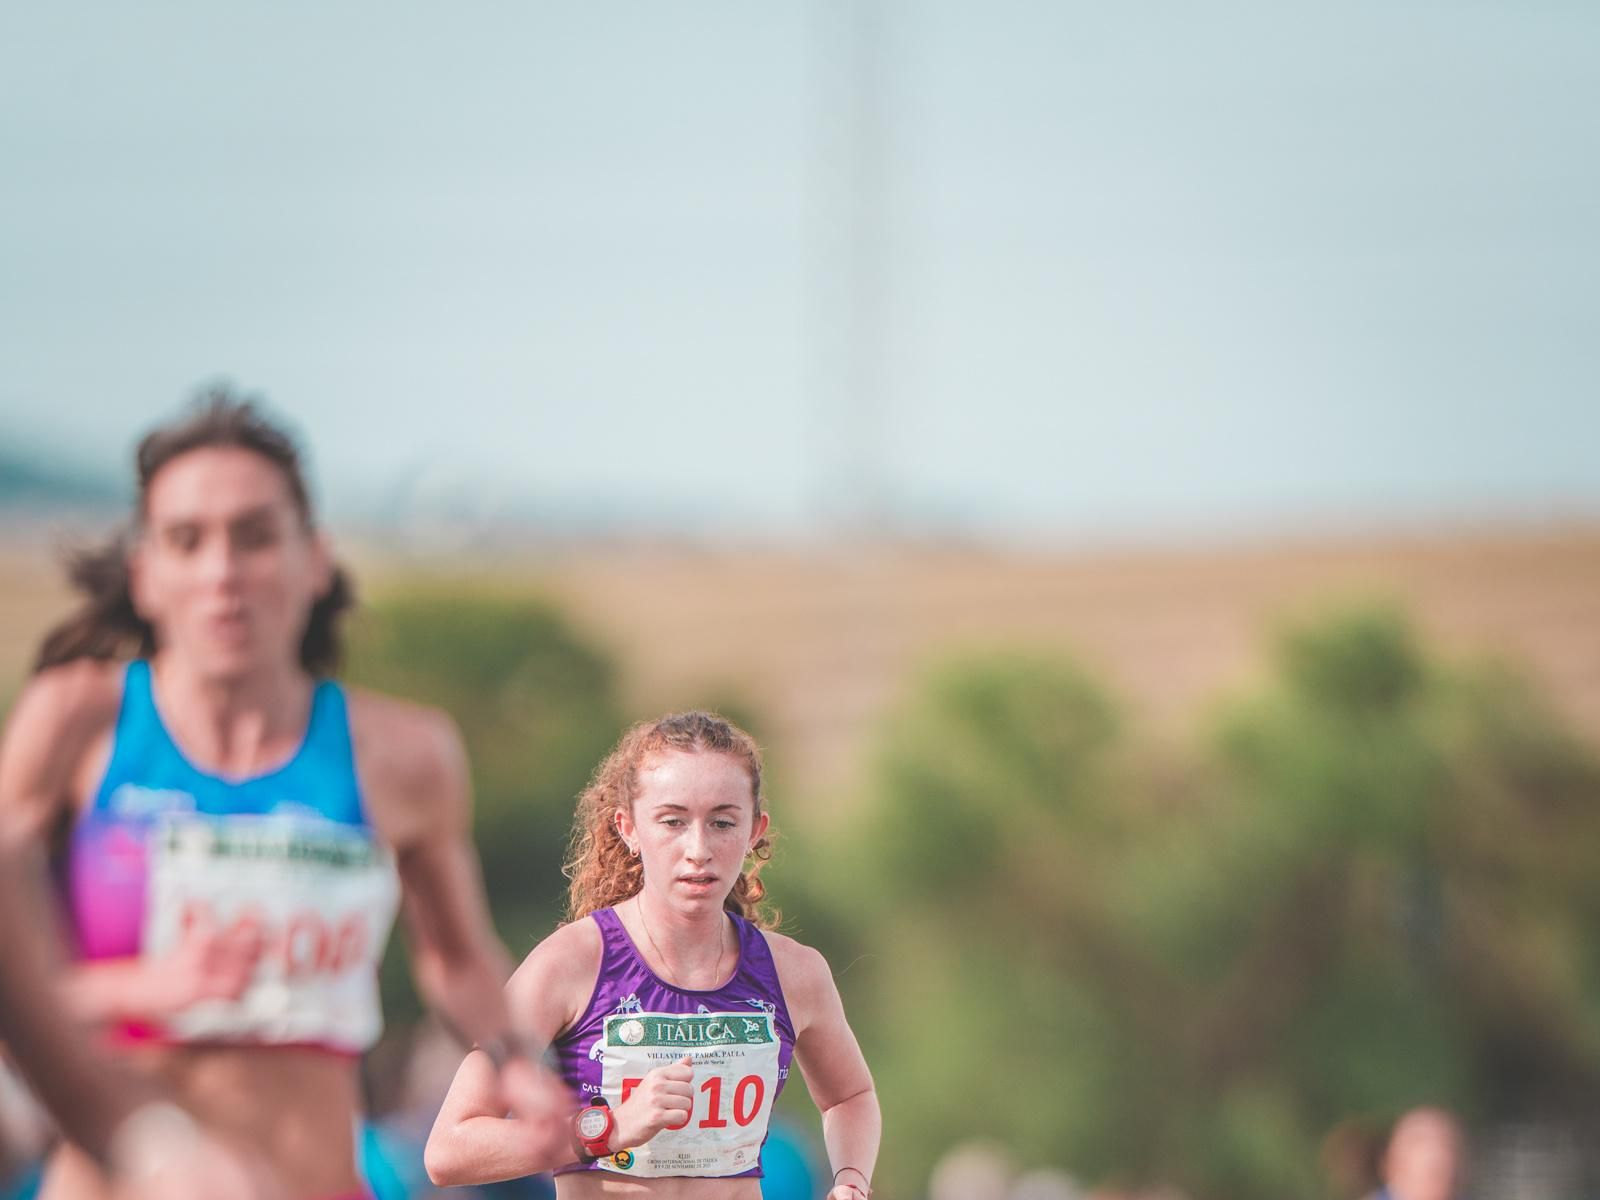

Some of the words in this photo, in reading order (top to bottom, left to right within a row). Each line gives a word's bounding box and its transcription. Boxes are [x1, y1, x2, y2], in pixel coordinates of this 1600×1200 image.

[657, 1020, 735, 1041] ITÁLICA
[722, 1050, 746, 1058] PAULA
[622, 1074, 764, 1130] 10
